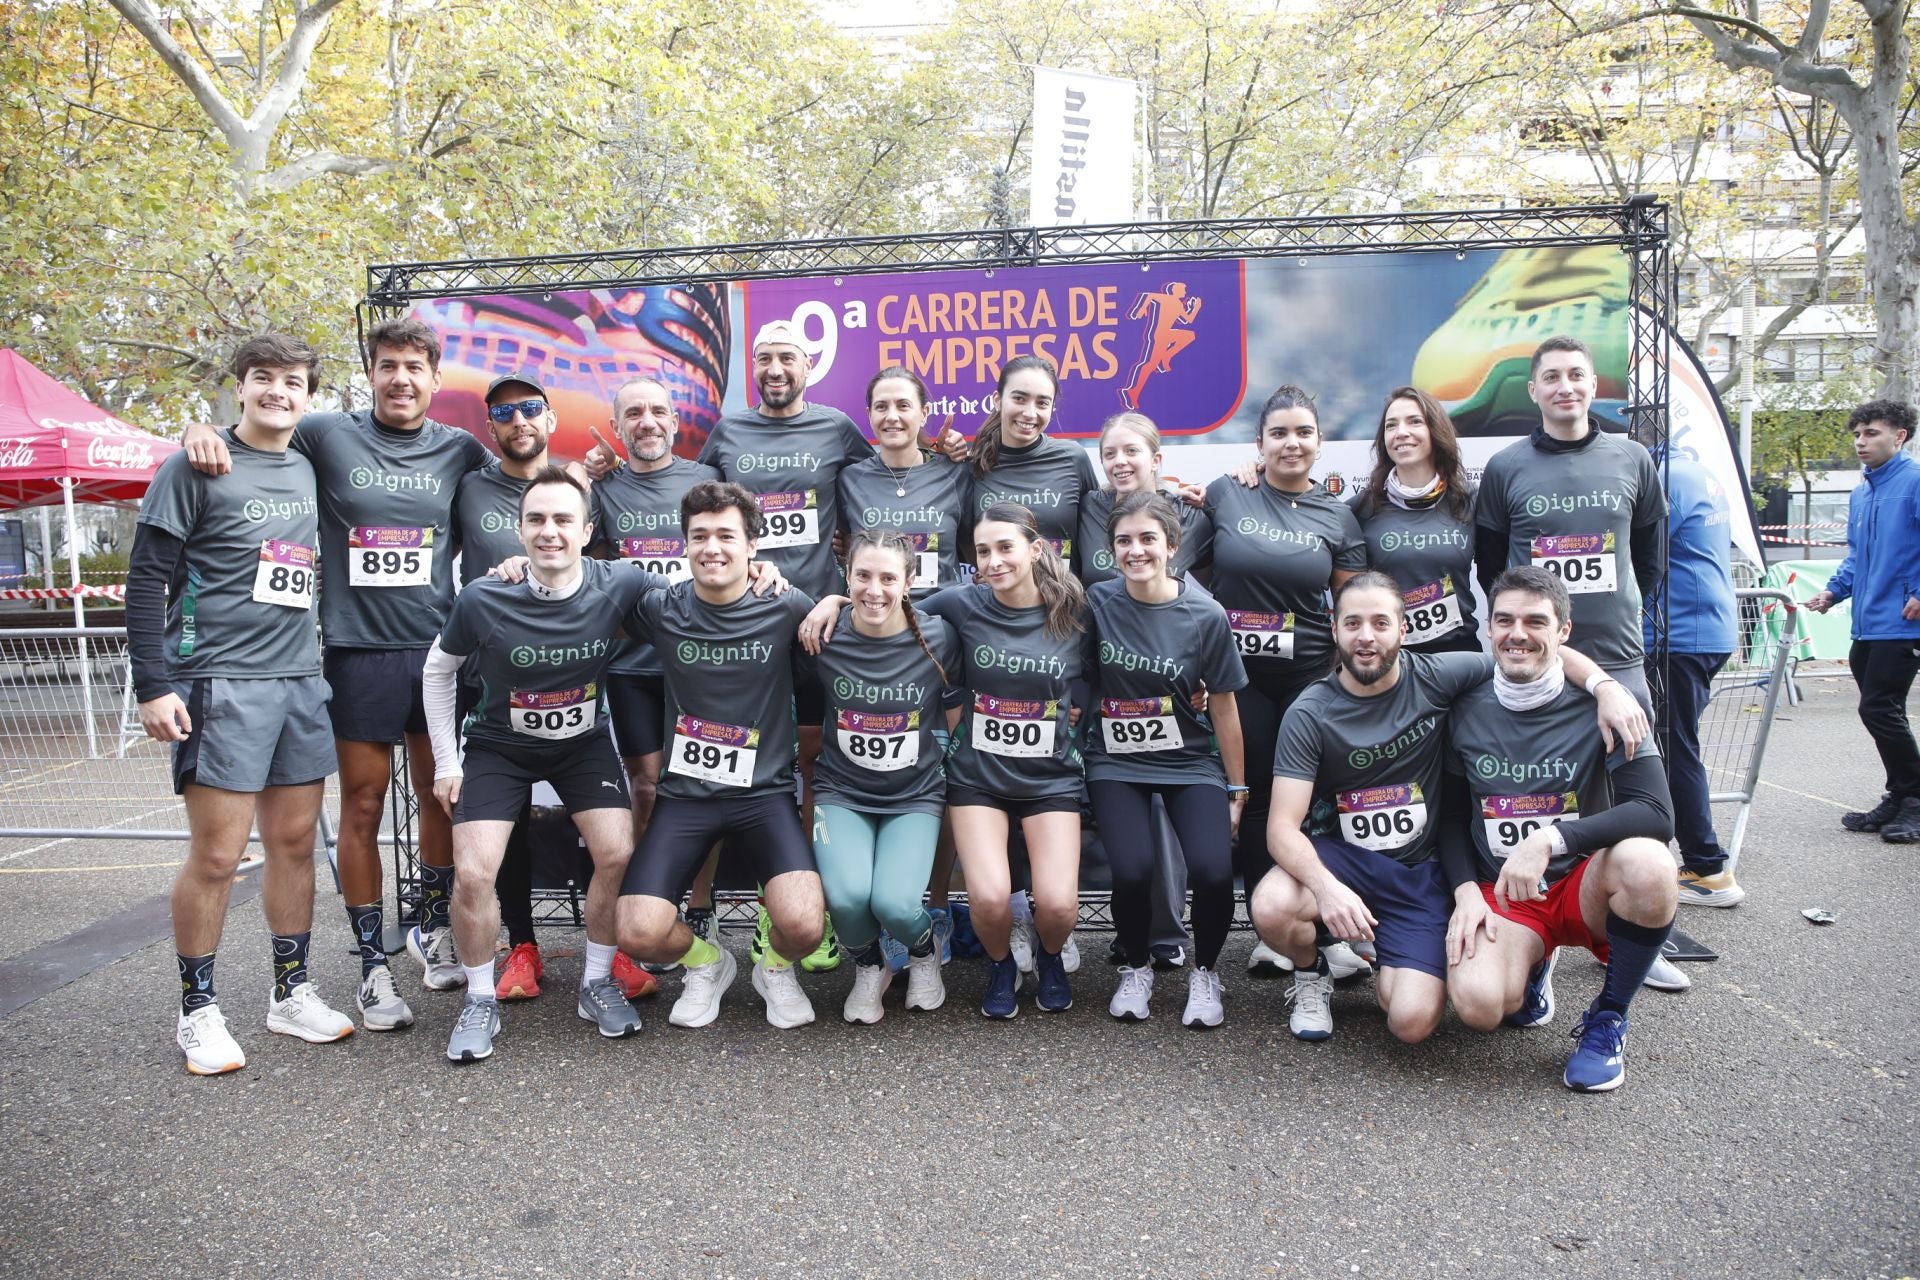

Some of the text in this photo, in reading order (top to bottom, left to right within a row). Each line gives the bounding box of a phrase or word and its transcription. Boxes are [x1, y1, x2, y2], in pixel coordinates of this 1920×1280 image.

[877, 286, 1119, 336] CARRERA DE
[959, 395, 979, 416] de
[737, 452, 821, 474] Signify
[349, 466, 442, 495] Signify
[863, 506, 944, 528] Signify
[1526, 490, 1622, 517] Signify
[1237, 516, 1323, 552] Signify
[1380, 529, 1469, 552] Signify
[362, 551, 420, 575] 895
[181, 615, 194, 643] RUN
[510, 638, 610, 668] Signify
[677, 640, 773, 666] Signify
[974, 644, 1067, 680] Signify
[1099, 640, 1184, 681] Signify
[833, 675, 925, 705] Signify
[523, 706, 584, 731] 903
[984, 718, 1041, 746] 890
[1111, 719, 1167, 744] 892
[683, 740, 739, 774] 891
[849, 734, 906, 760] 897
[1476, 753, 1578, 783] Signify
[1361, 787, 1395, 799] CARRERA DE
[1362, 793, 1396, 804] EMPRESAS
[1351, 808, 1414, 840] 906
[1498, 817, 1562, 847] 90
